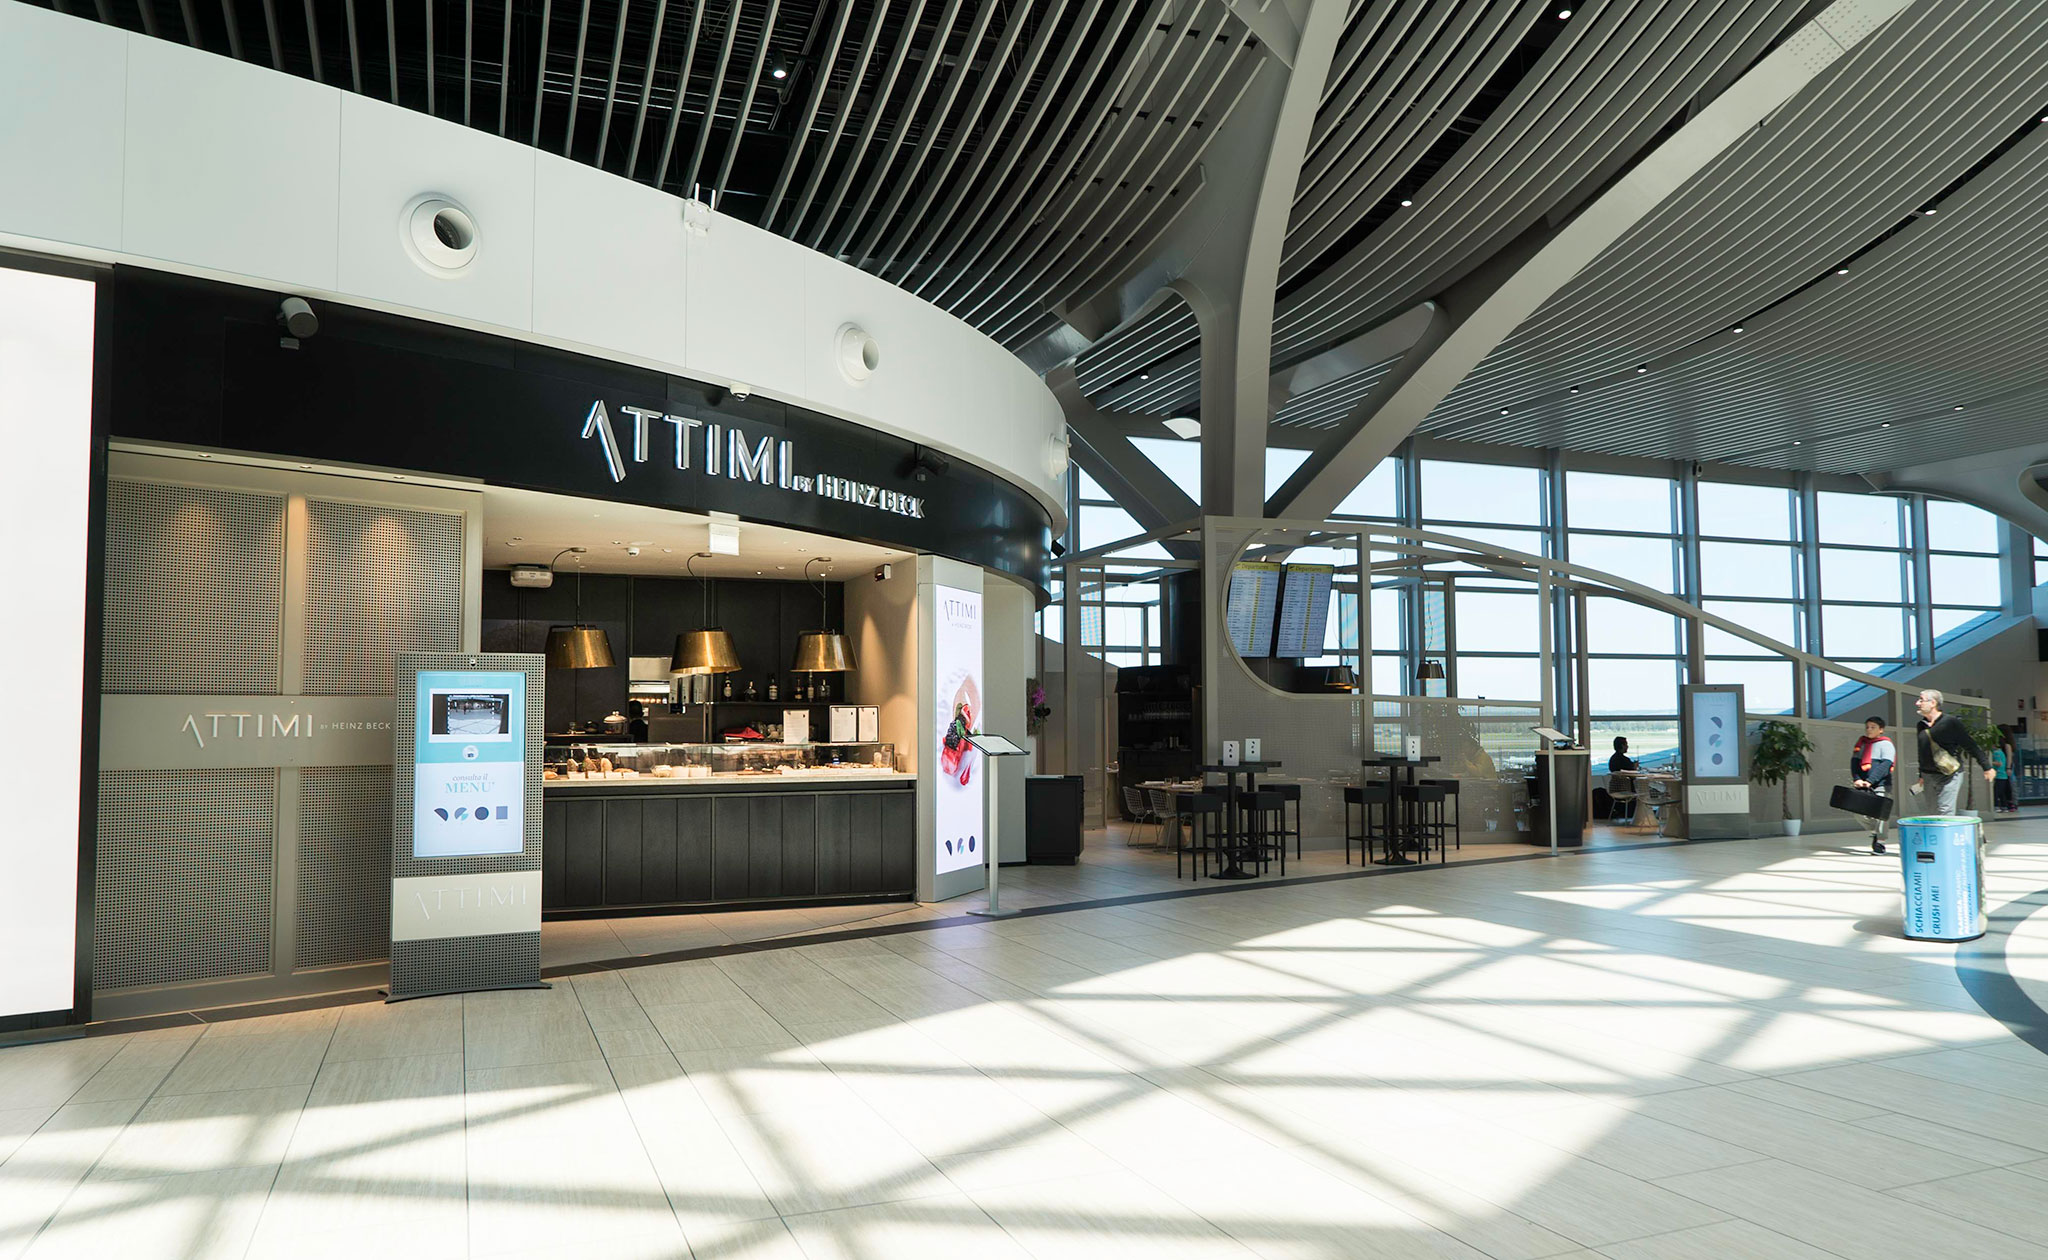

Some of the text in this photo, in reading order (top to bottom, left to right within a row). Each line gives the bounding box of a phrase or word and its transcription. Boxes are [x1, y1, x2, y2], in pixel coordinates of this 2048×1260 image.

[581, 399, 925, 519] ATTIMI BY HEINZ BECK
[944, 600, 976, 621] ATTIMI
[181, 714, 313, 749] ATTIMI
[332, 722, 363, 730] HEINZ
[366, 722, 391, 730] BECK
[452, 773, 482, 781] consulta
[412, 884, 526, 921] ATTIMI
[1914, 872, 1924, 934] SCHIACCIAMI!
[1931, 885, 1941, 935] CRUSH ME!
